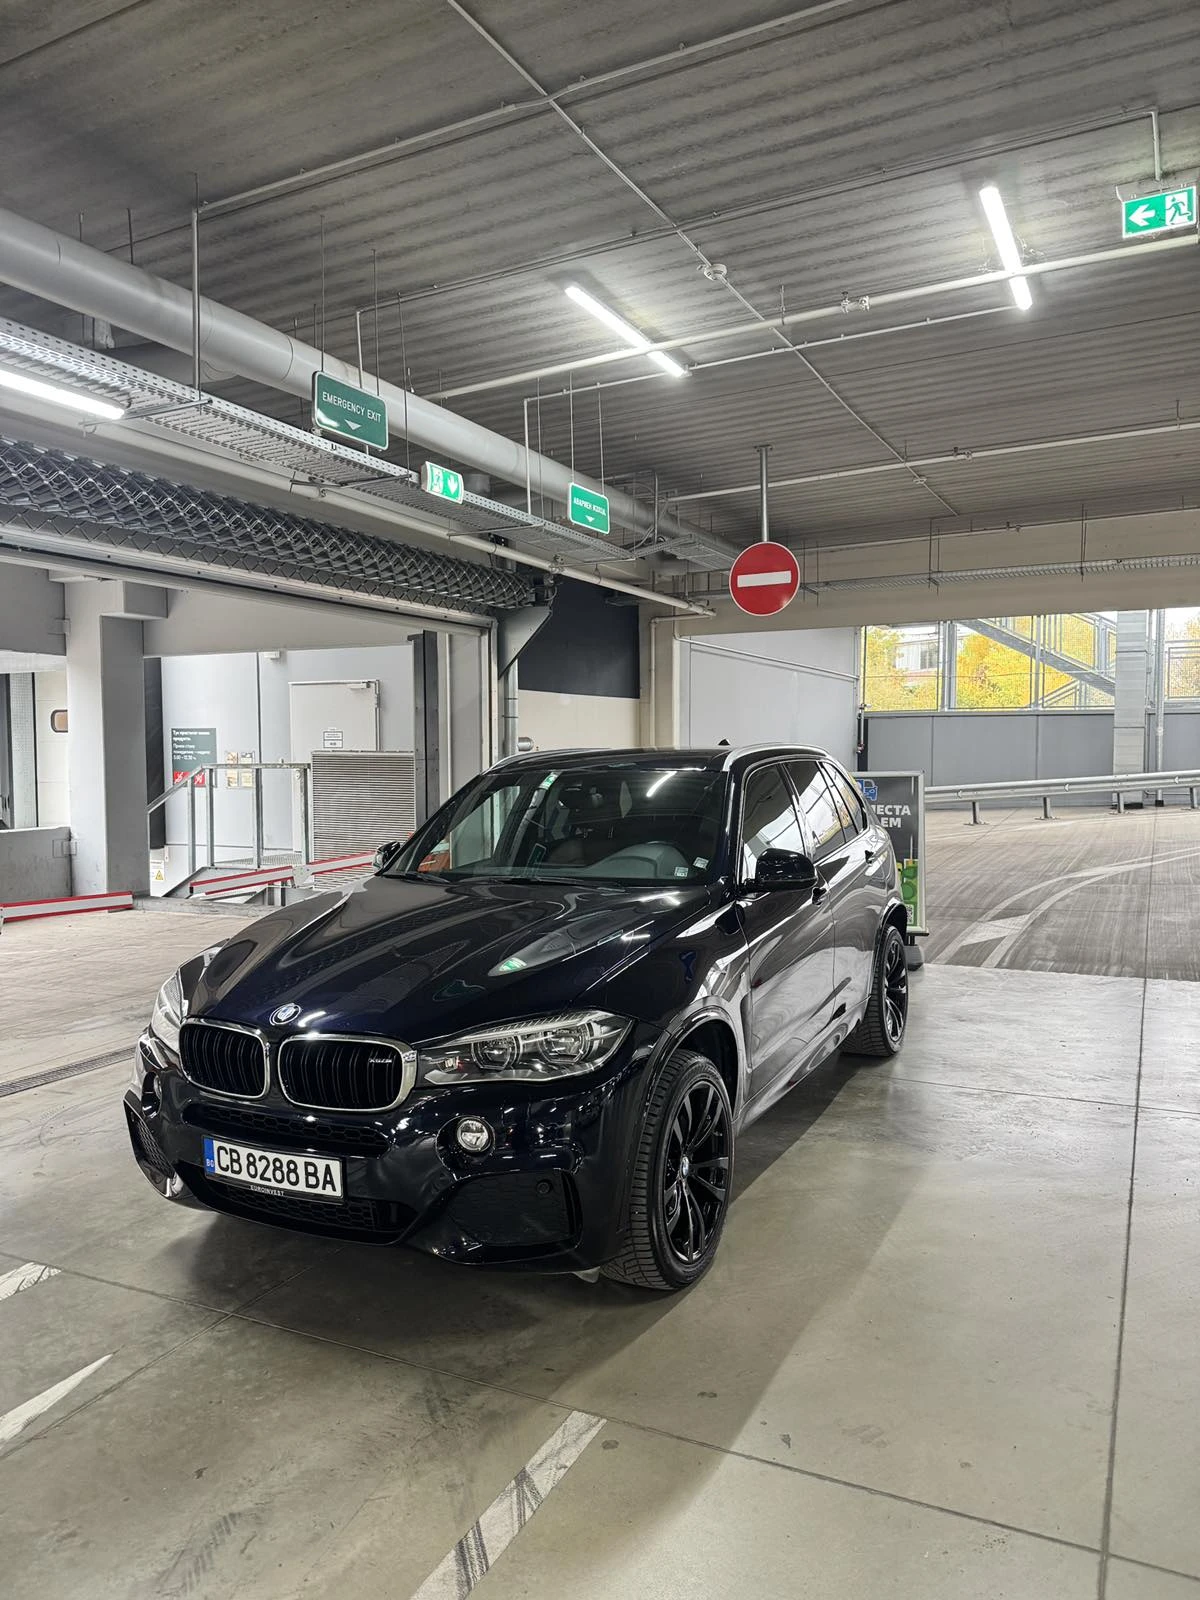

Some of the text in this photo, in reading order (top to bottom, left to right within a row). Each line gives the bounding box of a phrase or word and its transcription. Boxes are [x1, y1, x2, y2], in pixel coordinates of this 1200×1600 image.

[322, 392, 381, 423] EMERGENCY EXIT
[880, 817, 902, 828] ЕМ
[246, 1152, 300, 1186] 8288
